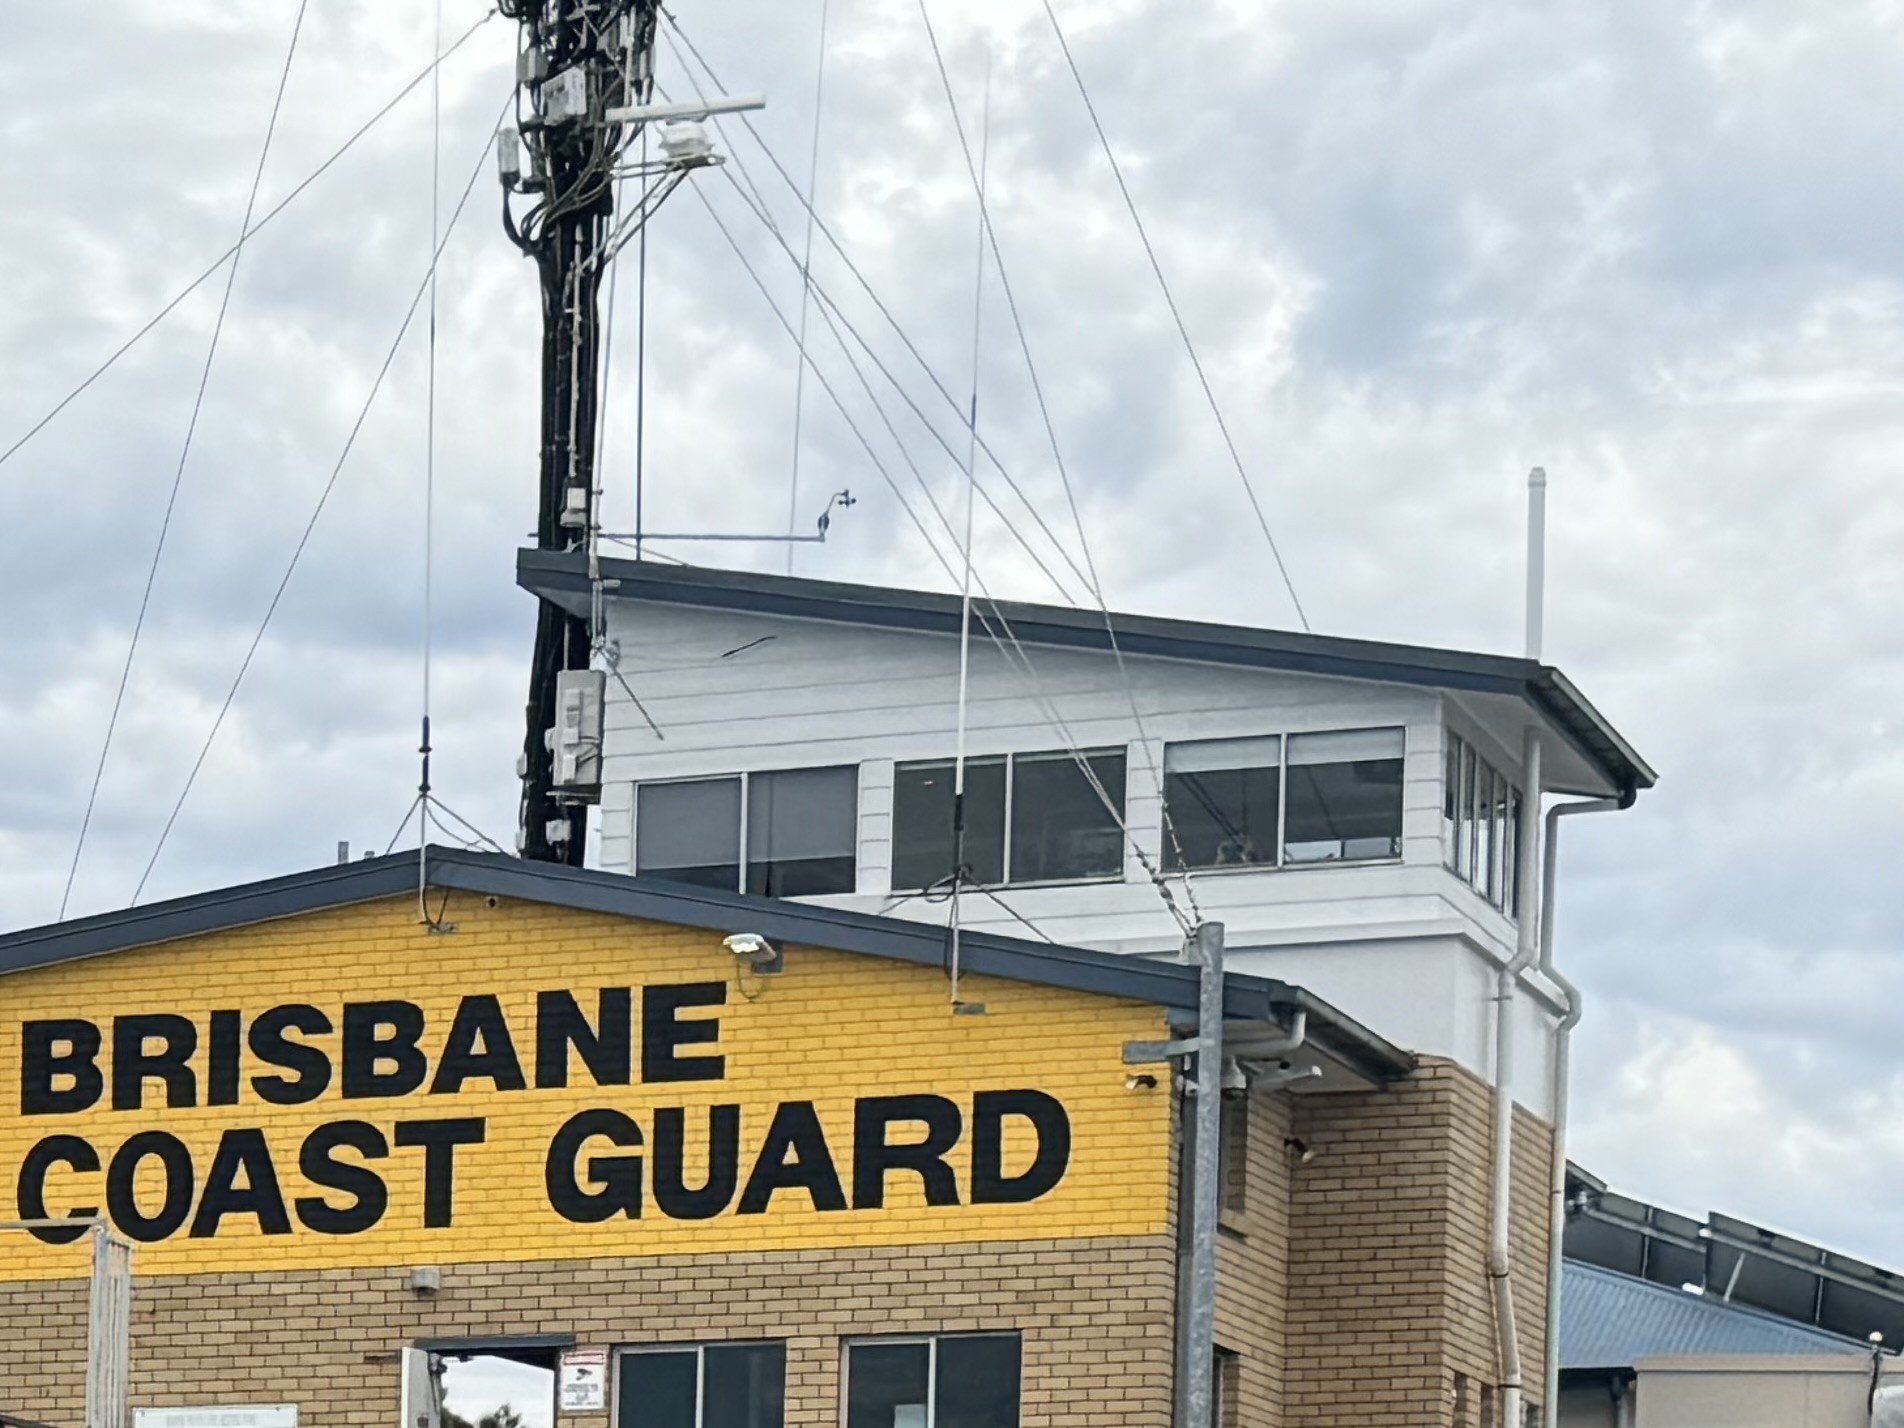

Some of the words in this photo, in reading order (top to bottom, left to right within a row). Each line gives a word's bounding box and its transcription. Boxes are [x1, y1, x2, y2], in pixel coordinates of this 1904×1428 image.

[19, 980, 727, 1116] BRISBANE
[16, 1116, 484, 1244] COAST
[544, 1089, 1070, 1224] GUARD
